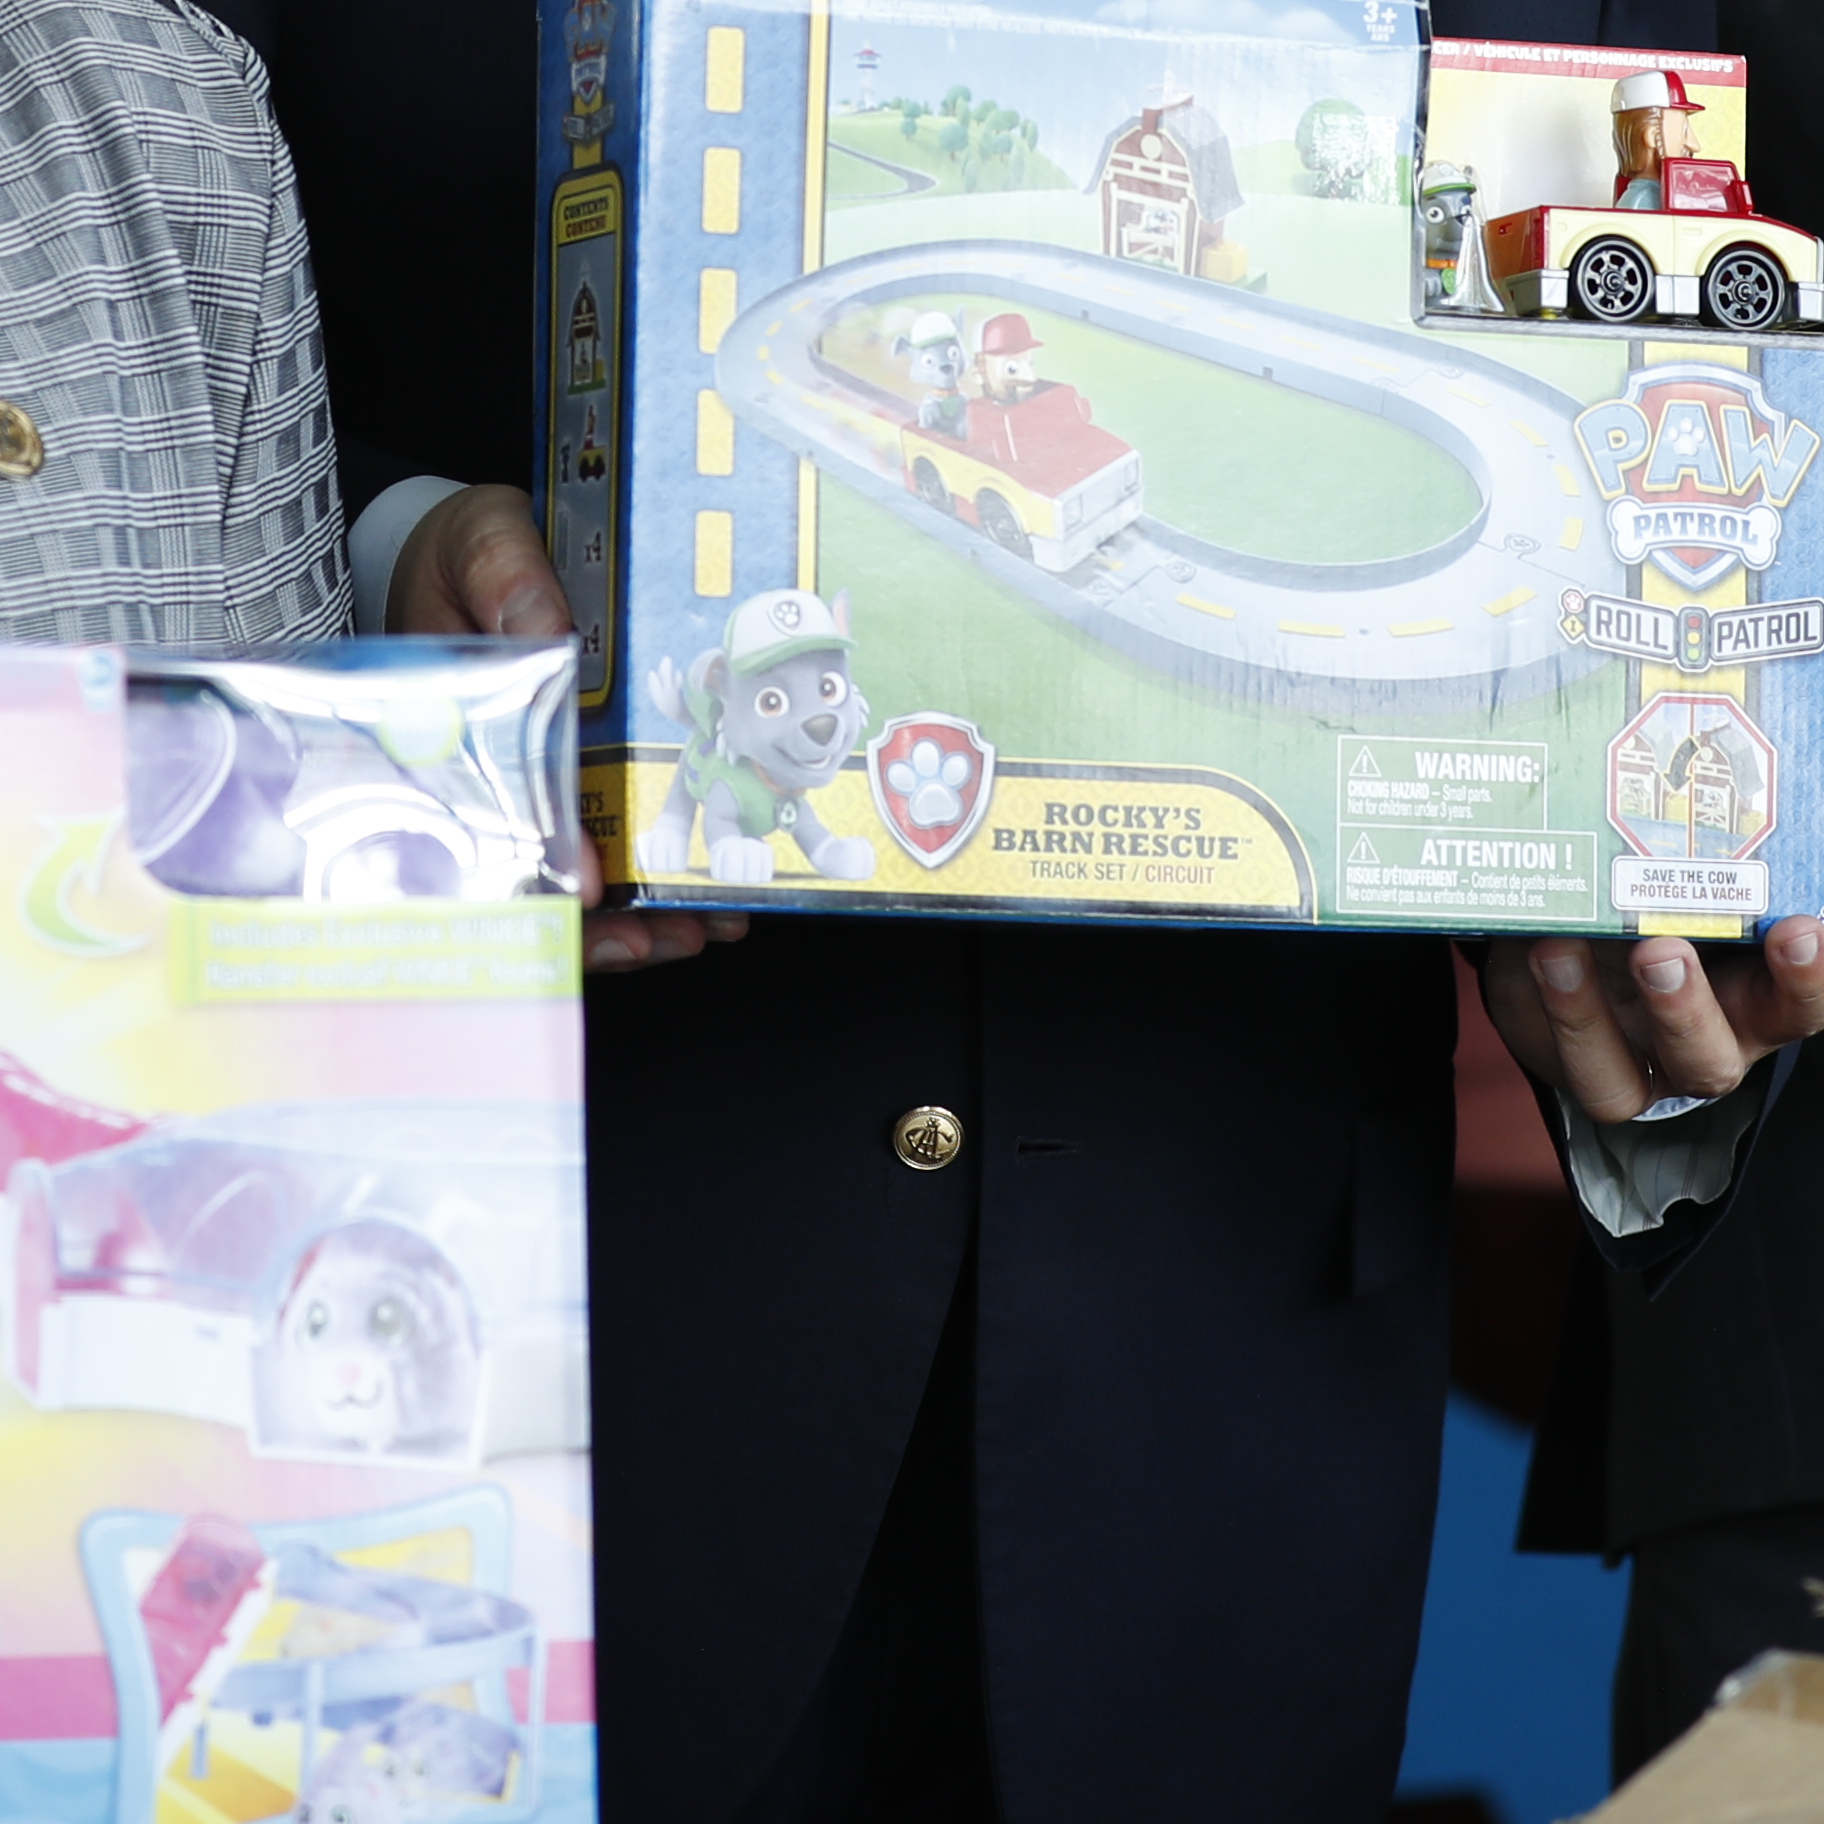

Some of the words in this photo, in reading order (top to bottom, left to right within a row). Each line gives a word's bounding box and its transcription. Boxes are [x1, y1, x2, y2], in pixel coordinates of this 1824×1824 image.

[1362, 0, 1398, 24] 3+
[1474, 41, 1541, 62] VÉHICULE
[1544, 48, 1560, 63] ET
[1563, 50, 1656, 68] PERSONNAGE
[1659, 56, 1734, 74] EXCLUSIFS
[1574, 398, 1821, 507] PAW
[1633, 511, 1759, 547] PATROL
[1595, 604, 1668, 652] ROLL
[1717, 610, 1818, 654] PATROL
[1415, 751, 1540, 783] WARNING:
[1347, 779, 1389, 798] CHOKING
[1391, 781, 1430, 800] HAZARD
[1442, 783, 1466, 802] Small
[1467, 786, 1493, 804] parts.
[1043, 802, 1201, 831] ROCKY'S
[1347, 798, 1363, 815] Not
[1364, 798, 1376, 816] for
[1378, 799, 1412, 816] children
[1414, 800, 1439, 817] under
[1440, 802, 1447, 817] 3
[1448, 803, 1474, 821] years.
[992, 828, 1094, 856] BARN
[1420, 838, 1556, 870] ATTENTION
[1565, 843, 1573, 871] !
[1029, 859, 1088, 881] TRACK
[1094, 861, 1126, 882] SET
[1132, 863, 1140, 882] /
[1144, 863, 1215, 884] CIRCUIT
[1346, 866, 1381, 887] RISQUE
[1471, 871, 1508, 890] Contient
[1509, 873, 1521, 890] de
[1522, 875, 1546, 893] petits
[1642, 868, 1675, 884] SAVE
[1679, 869, 1704, 884] THE
[1708, 871, 1737, 885] COW
[1346, 884, 1359, 902] Ne
[1360, 885, 1397, 903] convient
[1398, 889, 1415, 906] pas
[1416, 891, 1432, 905] aux
[1434, 887, 1465, 905] enfants
[1467, 889, 1478, 906] de
[1479, 890, 1506, 907] moins
[1507, 891, 1519, 907] de
[1520, 891, 1526, 908] 3
[1630, 880, 1688, 899] PROTÈGE
[1692, 886, 1708, 899] LA
[1711, 887, 1752, 901] VACHE
